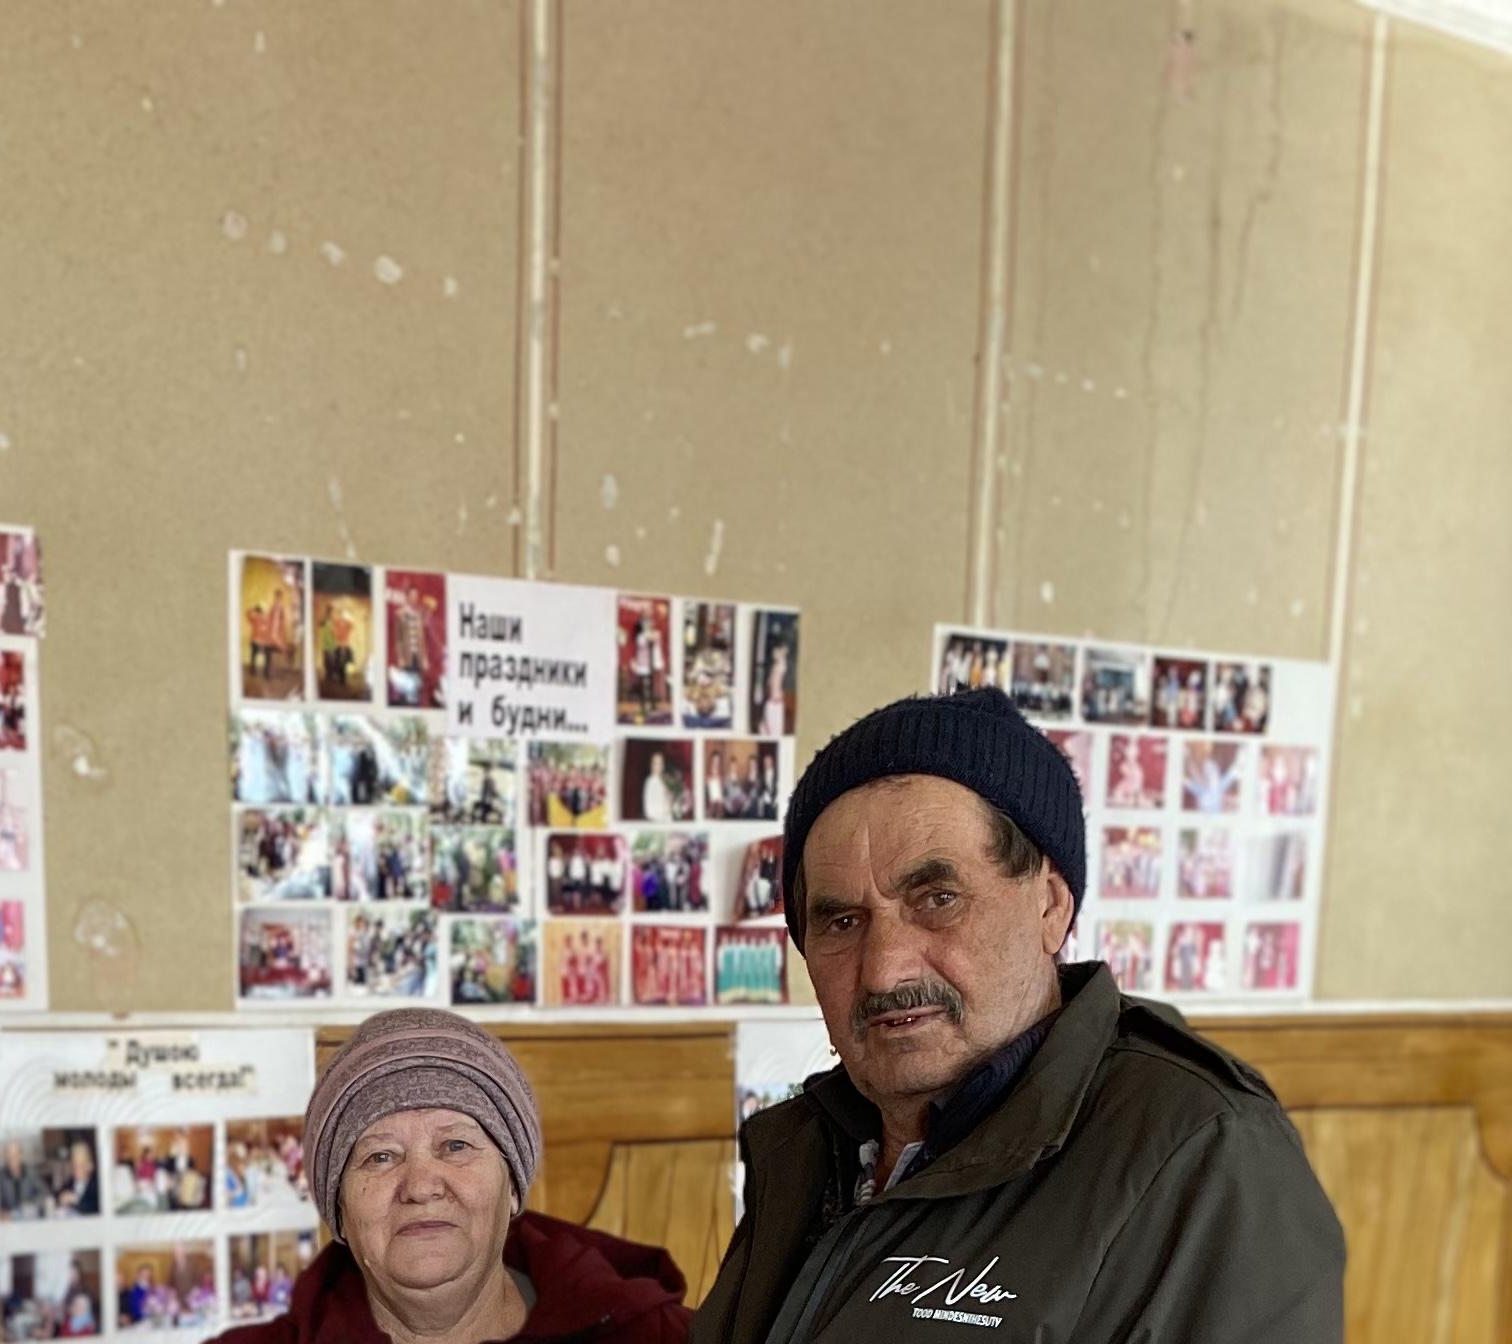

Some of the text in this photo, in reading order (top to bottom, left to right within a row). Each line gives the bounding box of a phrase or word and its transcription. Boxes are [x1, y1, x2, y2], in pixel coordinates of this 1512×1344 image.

[459, 601, 522, 644] Наши
[459, 651, 588, 689] праздники
[458, 700, 473, 725] и
[53, 1070, 136, 1092] молоды
[869, 1255, 949, 1302] The
